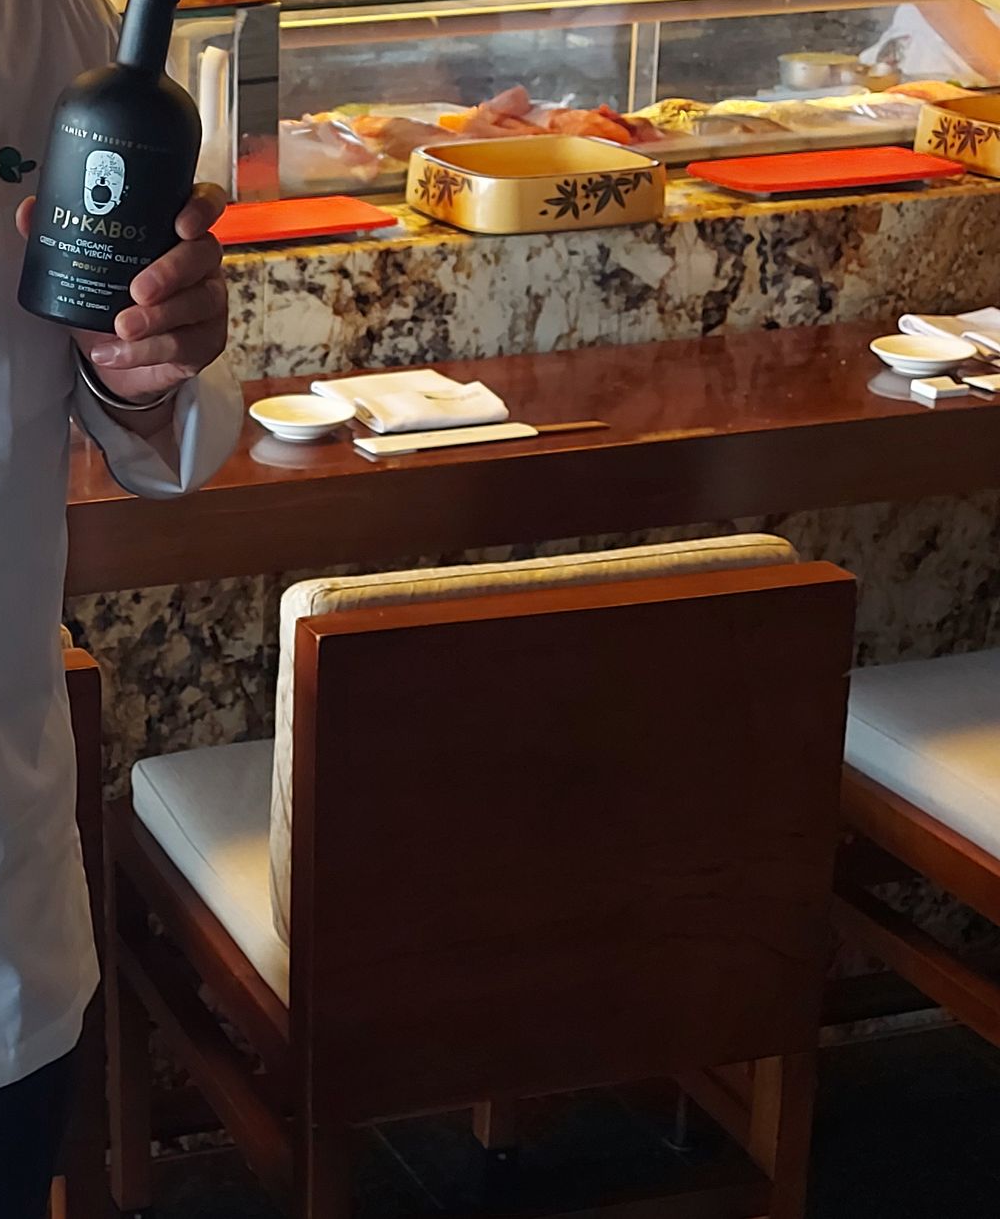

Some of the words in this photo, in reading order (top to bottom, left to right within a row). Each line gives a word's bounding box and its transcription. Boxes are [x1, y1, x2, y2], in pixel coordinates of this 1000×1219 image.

[61, 124, 88, 139] FAMILY
[75, 238, 114, 253] ORGANIC
[58, 242, 81, 254] EXTRA
[84, 248, 113, 261] VIRGIN
[115, 254, 138, 265] OLIVE
[72, 260, 109, 274] ROBUST
